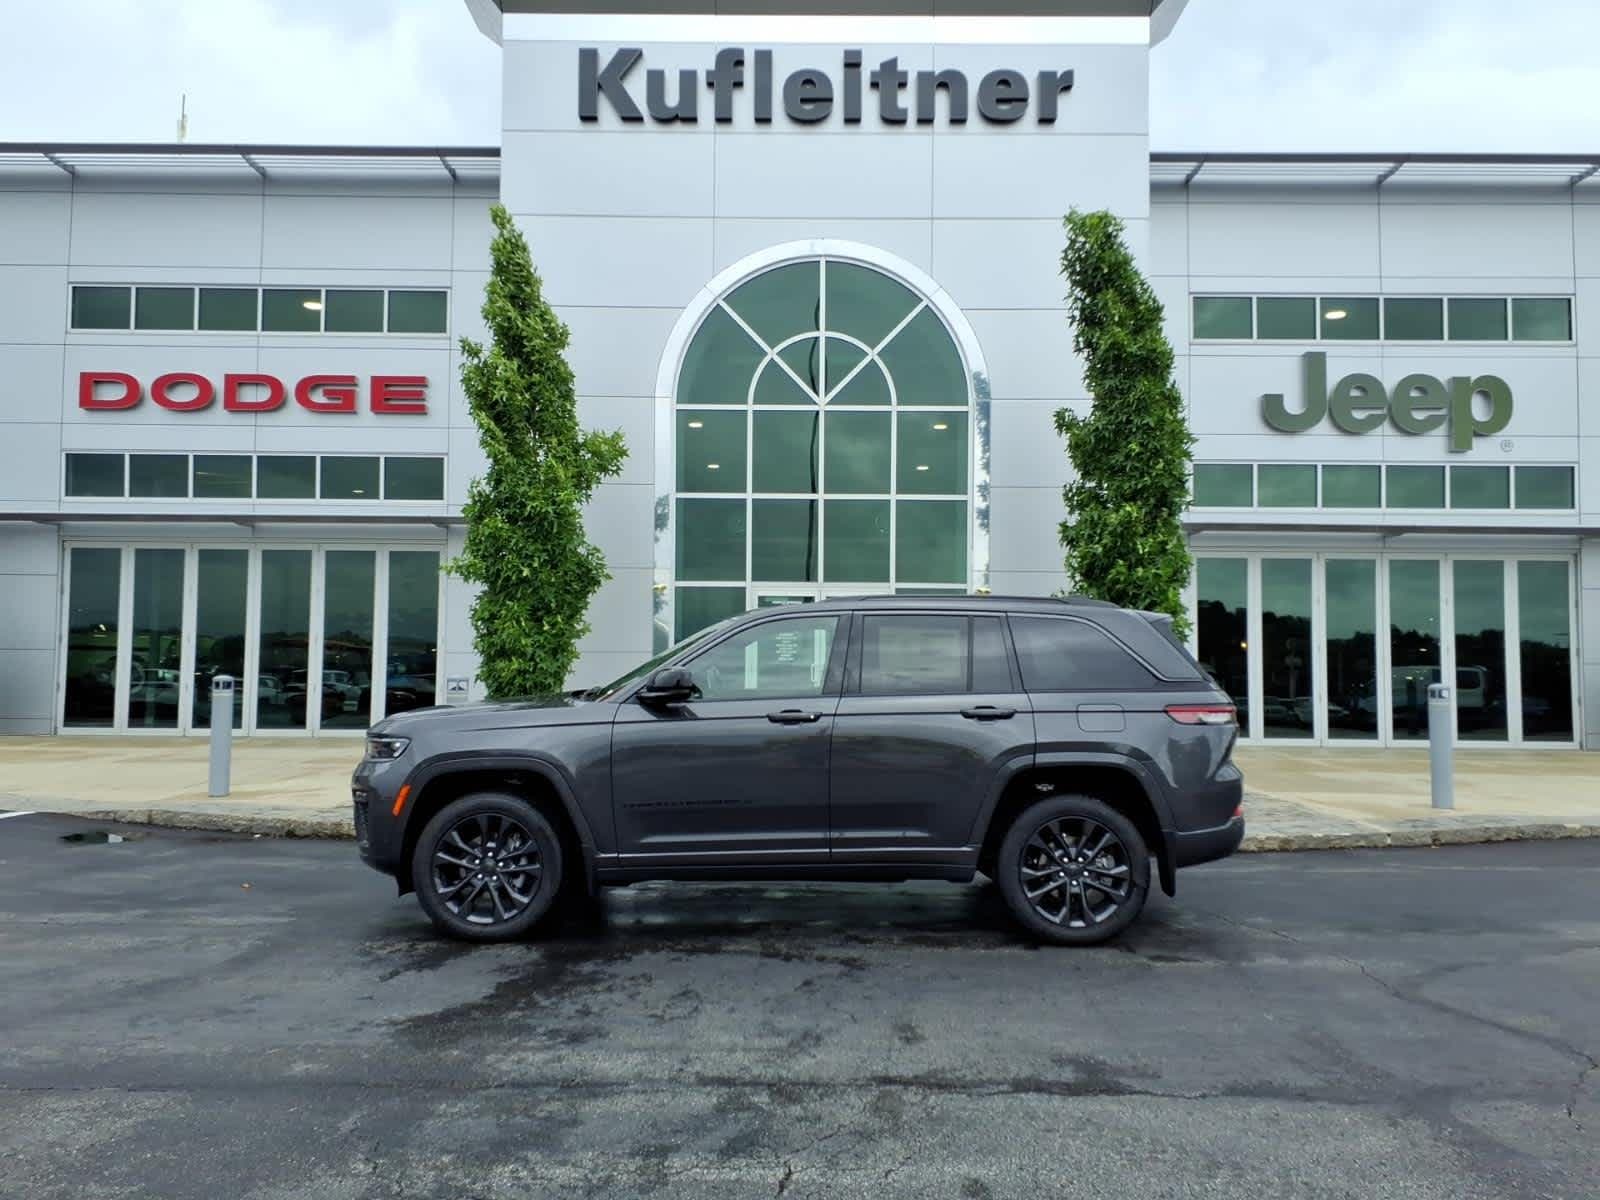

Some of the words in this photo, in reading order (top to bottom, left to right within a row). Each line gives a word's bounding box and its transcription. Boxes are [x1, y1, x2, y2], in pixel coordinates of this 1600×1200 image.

[578, 48, 1075, 124] Kufleitner
[79, 372, 428, 415] DODGE
[1262, 351, 1513, 453] Jeep
